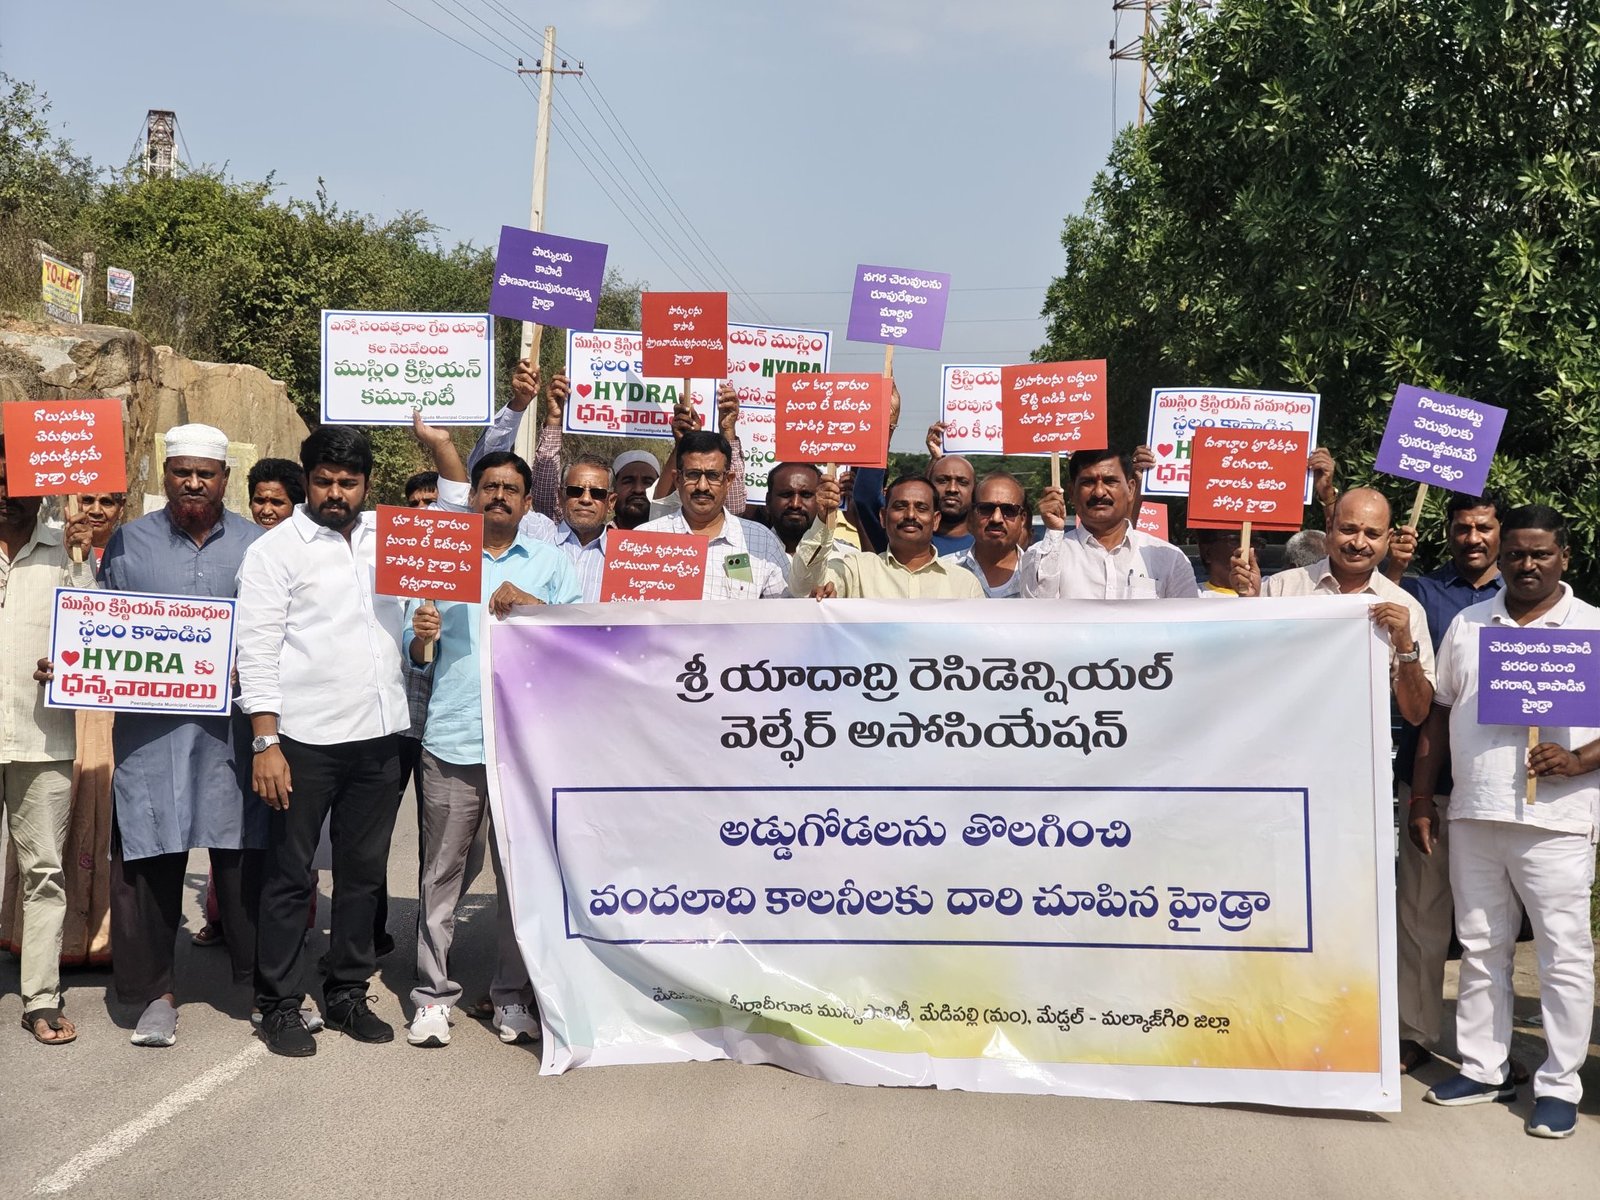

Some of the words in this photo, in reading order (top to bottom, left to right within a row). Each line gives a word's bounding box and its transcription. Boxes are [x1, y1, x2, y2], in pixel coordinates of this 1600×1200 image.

[532, 246, 572, 263] పార్కులను
[45, 261, 80, 292] TO-LET
[535, 265, 562, 277] కాపాడి
[863, 272, 886, 283] నగర
[889, 274, 942, 289] చెరువులను
[532, 297, 554, 310] హైడ్రా
[871, 290, 927, 304] రూపురేఖలు
[668, 305, 702, 319] పార్కులను
[880, 307, 913, 322] మార్చిన
[360, 322, 425, 335] సంవత్సరాల
[673, 322, 695, 331] కాపాడి
[880, 324, 907, 337] హైడ్రా
[369, 344, 385, 354] కల
[390, 342, 448, 354] నెరవేరింది
[575, 336, 611, 353] ముస్లిం
[771, 334, 823, 355] ముస్లిం
[591, 357, 629, 378] స్థలం
[674, 354, 693, 366] హైడ్రా
[334, 359, 399, 382] ముస్లిం
[404, 359, 481, 383] క్రిస్టియన్
[594, 381, 679, 404] HYDRA
[792, 379, 810, 392] భూ
[813, 379, 833, 396] కబ్జా
[837, 381, 869, 390] దారుల
[361, 384, 455, 412] కమ్యూనిటీ
[1070, 391, 1092, 402] బాట
[1159, 395, 1197, 412] ముస్లిం
[1200, 395, 1251, 414] క్రిస్టియన్
[1254, 398, 1311, 414] సమాధుల
[786, 400, 817, 413] నుంచి
[946, 400, 992, 413] తరపున
[1418, 397, 1484, 428] గొలుసుకట్టు
[34, 409, 95, 426] గొలుసుకట్టు
[1019, 412, 1052, 425] చూపిన
[785, 421, 825, 433] కాపాడిన
[827, 422, 855, 434] హైడ్రా
[859, 421, 870, 431] కు
[1413, 417, 1474, 441] చెరువులకు
[35, 429, 93, 444] చెరువులకు
[800, 441, 856, 455] ధన్యవాదాలు
[1251, 439, 1298, 454] పూడికను
[1399, 454, 1431, 473] హైడ్రా
[1433, 464, 1463, 481] లక్ష్యం
[35, 472, 66, 487] హైడ్రా
[70, 470, 98, 485] లక్ష్యం
[1206, 478, 1253, 489] నాలాలకు
[1212, 496, 1244, 511] పోసిన
[1246, 499, 1277, 513] హైడ్రా
[392, 514, 410, 526] భూ
[414, 515, 434, 534] కబ్జా
[437, 520, 469, 531] దారుల
[386, 534, 417, 547] నుంచి
[655, 546, 698, 558] వ్యవసాయ
[385, 555, 425, 570] కాపాడిన
[427, 559, 455, 573] హైడ్రా
[459, 560, 471, 572] కు
[610, 559, 660, 571] భూములుగా
[400, 575, 456, 591] ధన్యవాదాలు
[629, 577, 675, 594] కబ్జాదారుల
[61, 596, 105, 616] ముస్లిం
[108, 598, 165, 620] క్రిస్టియన్
[168, 605, 230, 620] సమాధుల
[79, 620, 126, 645] స్థలం
[132, 625, 212, 643] కాపాడిన
[1489, 641, 1550, 655] చెరువులను
[1553, 641, 1592, 654] కాపాడి
[82, 647, 184, 674] HYDRA
[194, 659, 214, 675] కు
[1501, 660, 1538, 672] వరదల
[1541, 661, 1576, 673] నుంచి
[676, 653, 714, 703] శ్రీ
[720, 659, 900, 701] యాదాద్రి
[909, 652, 1174, 705] రెసిడెన్షియల్
[1490, 679, 1537, 695] నగరాన్ని
[1537, 679, 1586, 692] కాపాడిన
[61, 673, 217, 704] ధన్యవాదాలు
[1522, 699, 1553, 713] హైడ్రా
[720, 708, 836, 769] వెల్ఫేర్
[848, 707, 1128, 755] అసోసియేషన్
[719, 807, 947, 861] అడ్డుగోడలను
[962, 812, 1132, 848] తొలగించి
[589, 883, 757, 917] వందలాది
[765, 878, 933, 916] కాలనీలకు
[946, 885, 1023, 916] దారి
[1032, 883, 1160, 918] చూపిన
[1168, 886, 1270, 933] హైడ్రా
[920, 1002, 979, 1027] మేడిపల్లి
[983, 1008, 1031, 1026] (మం),
[1037, 1005, 1085, 1032] మేడ్చల్
[1194, 1011, 1230, 1035] జిల్లా
